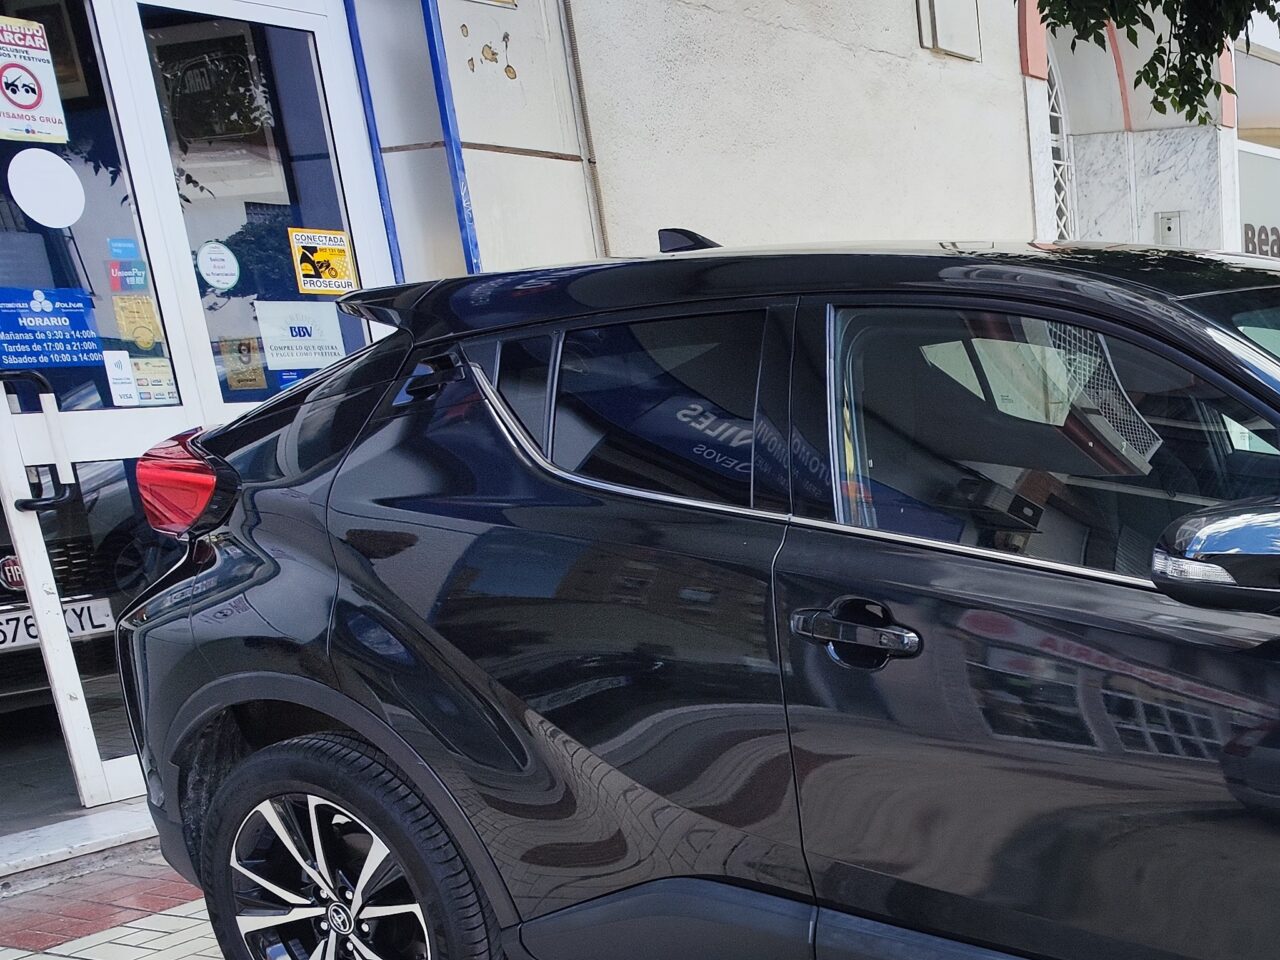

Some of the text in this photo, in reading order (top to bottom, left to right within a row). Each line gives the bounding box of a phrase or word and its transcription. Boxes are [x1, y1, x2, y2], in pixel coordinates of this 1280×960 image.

[19, 55, 51, 65] FESTIVOS
[294, 234, 345, 243] CONECTADA
[111, 268, 146, 277] UnionPay
[302, 280, 354, 289] PROSEGUR
[18, 317, 70, 327] HORARIO
[35, 331, 46, 340] de
[46, 330, 64, 339] 9:30
[71, 329, 96, 338] 14:00h
[289, 326, 313, 338] BBV
[2, 343, 31, 352] Tardes
[31, 343, 42, 351] de
[43, 342, 65, 351] 17:00
[71, 341, 97, 350] 21:00h
[2, 355, 38, 364] Sábados
[38, 354, 49, 363] de
[50, 353, 72, 362] 10:00
[79, 352, 104, 361] 14:00h
